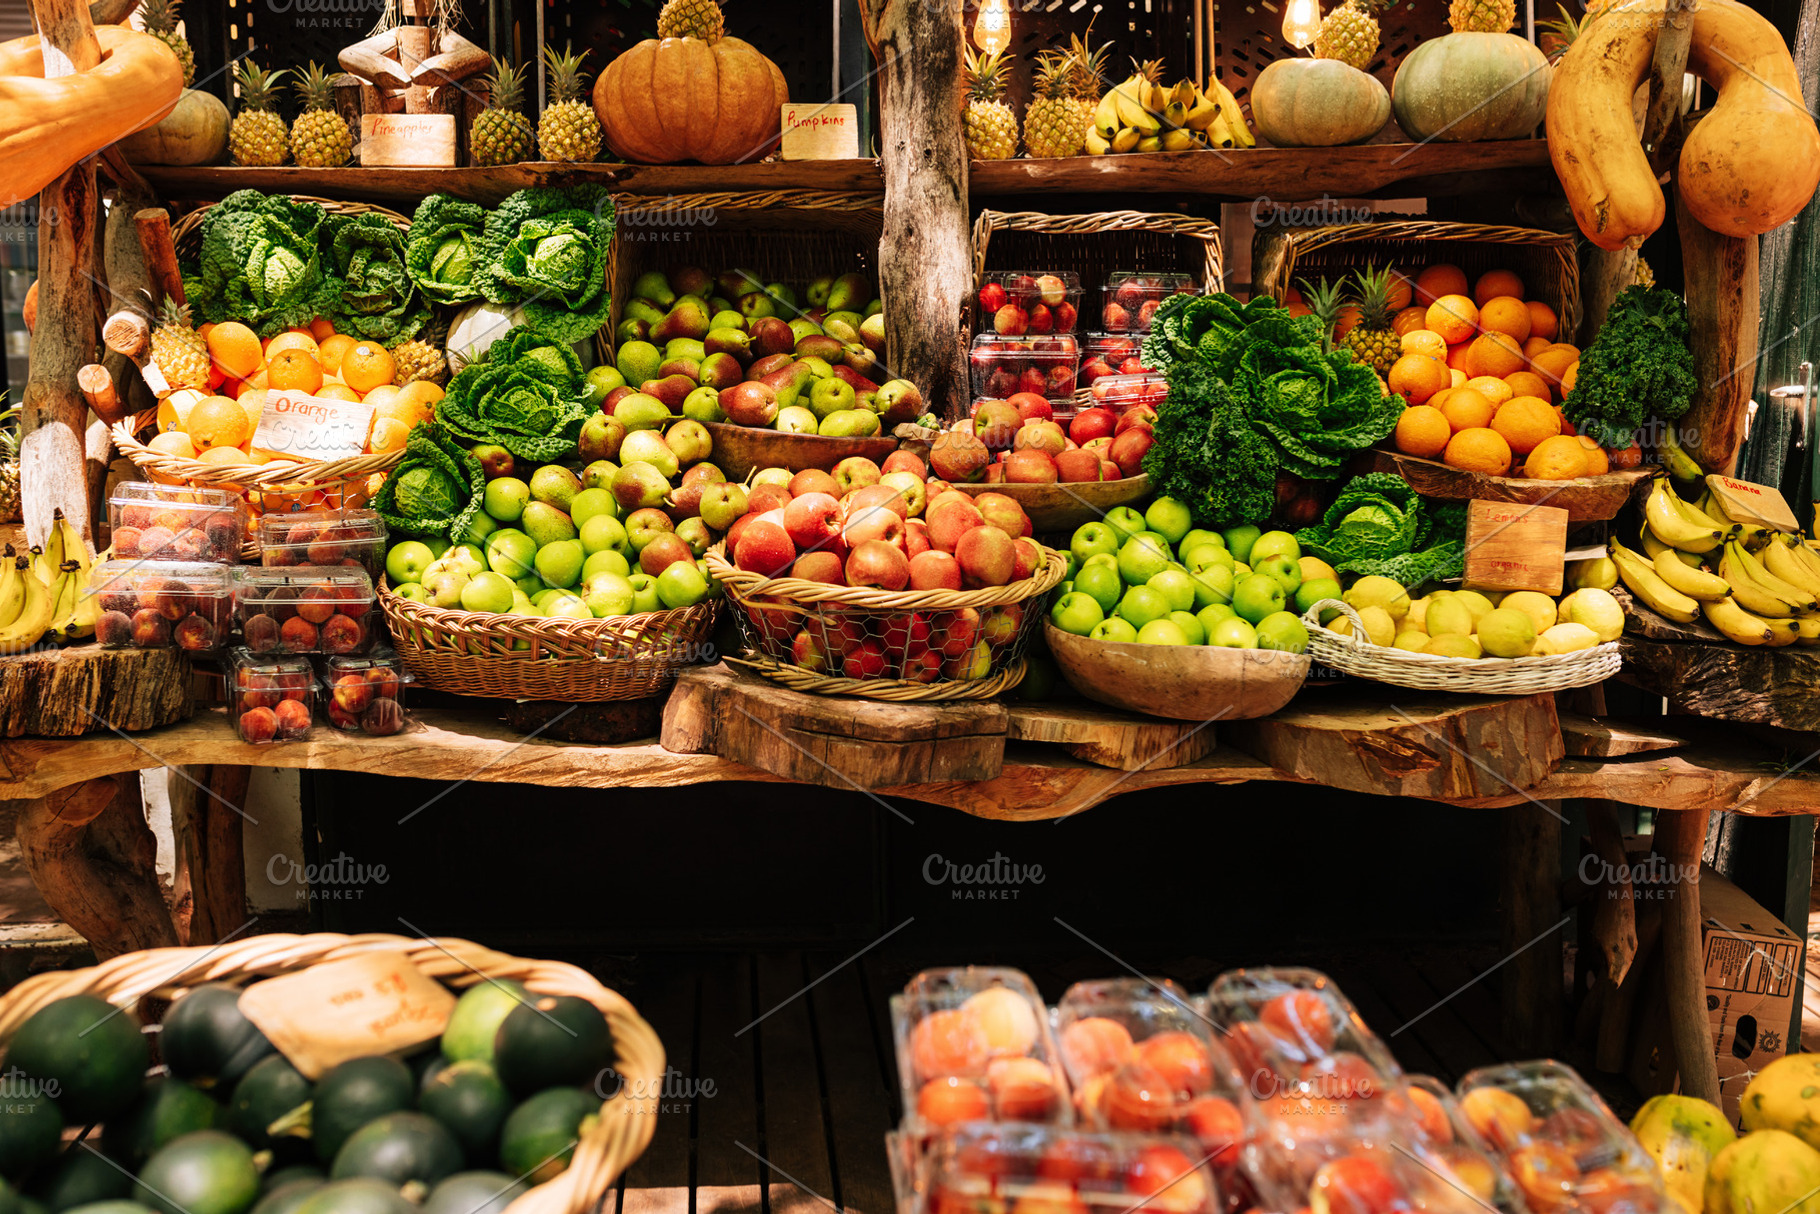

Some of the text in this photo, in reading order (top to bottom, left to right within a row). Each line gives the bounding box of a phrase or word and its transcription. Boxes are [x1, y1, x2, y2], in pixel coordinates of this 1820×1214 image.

[788, 110, 844, 132] Pumpkins
[275, 397, 340, 425] Orange
[1722, 476, 1762, 496] Banana
[1485, 508, 1529, 525] Lemons
